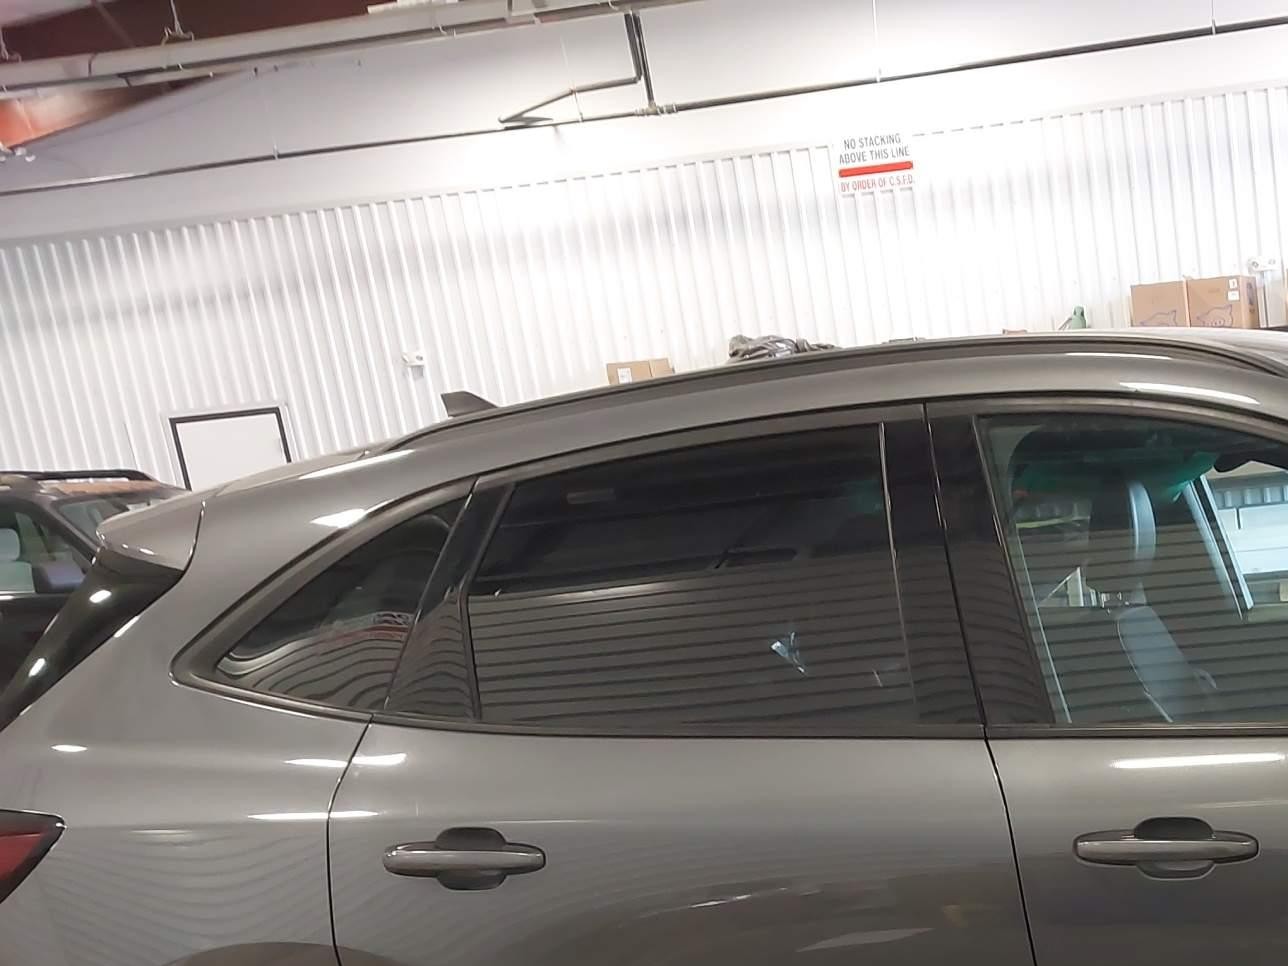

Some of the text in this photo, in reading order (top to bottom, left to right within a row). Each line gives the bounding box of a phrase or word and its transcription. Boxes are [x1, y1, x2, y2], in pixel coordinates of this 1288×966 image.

[844, 133, 901, 151] NO STACKING
[839, 144, 911, 165] ABOVE THIS LINE
[841, 181, 850, 193] BY
[852, 178, 877, 191] ORDER
